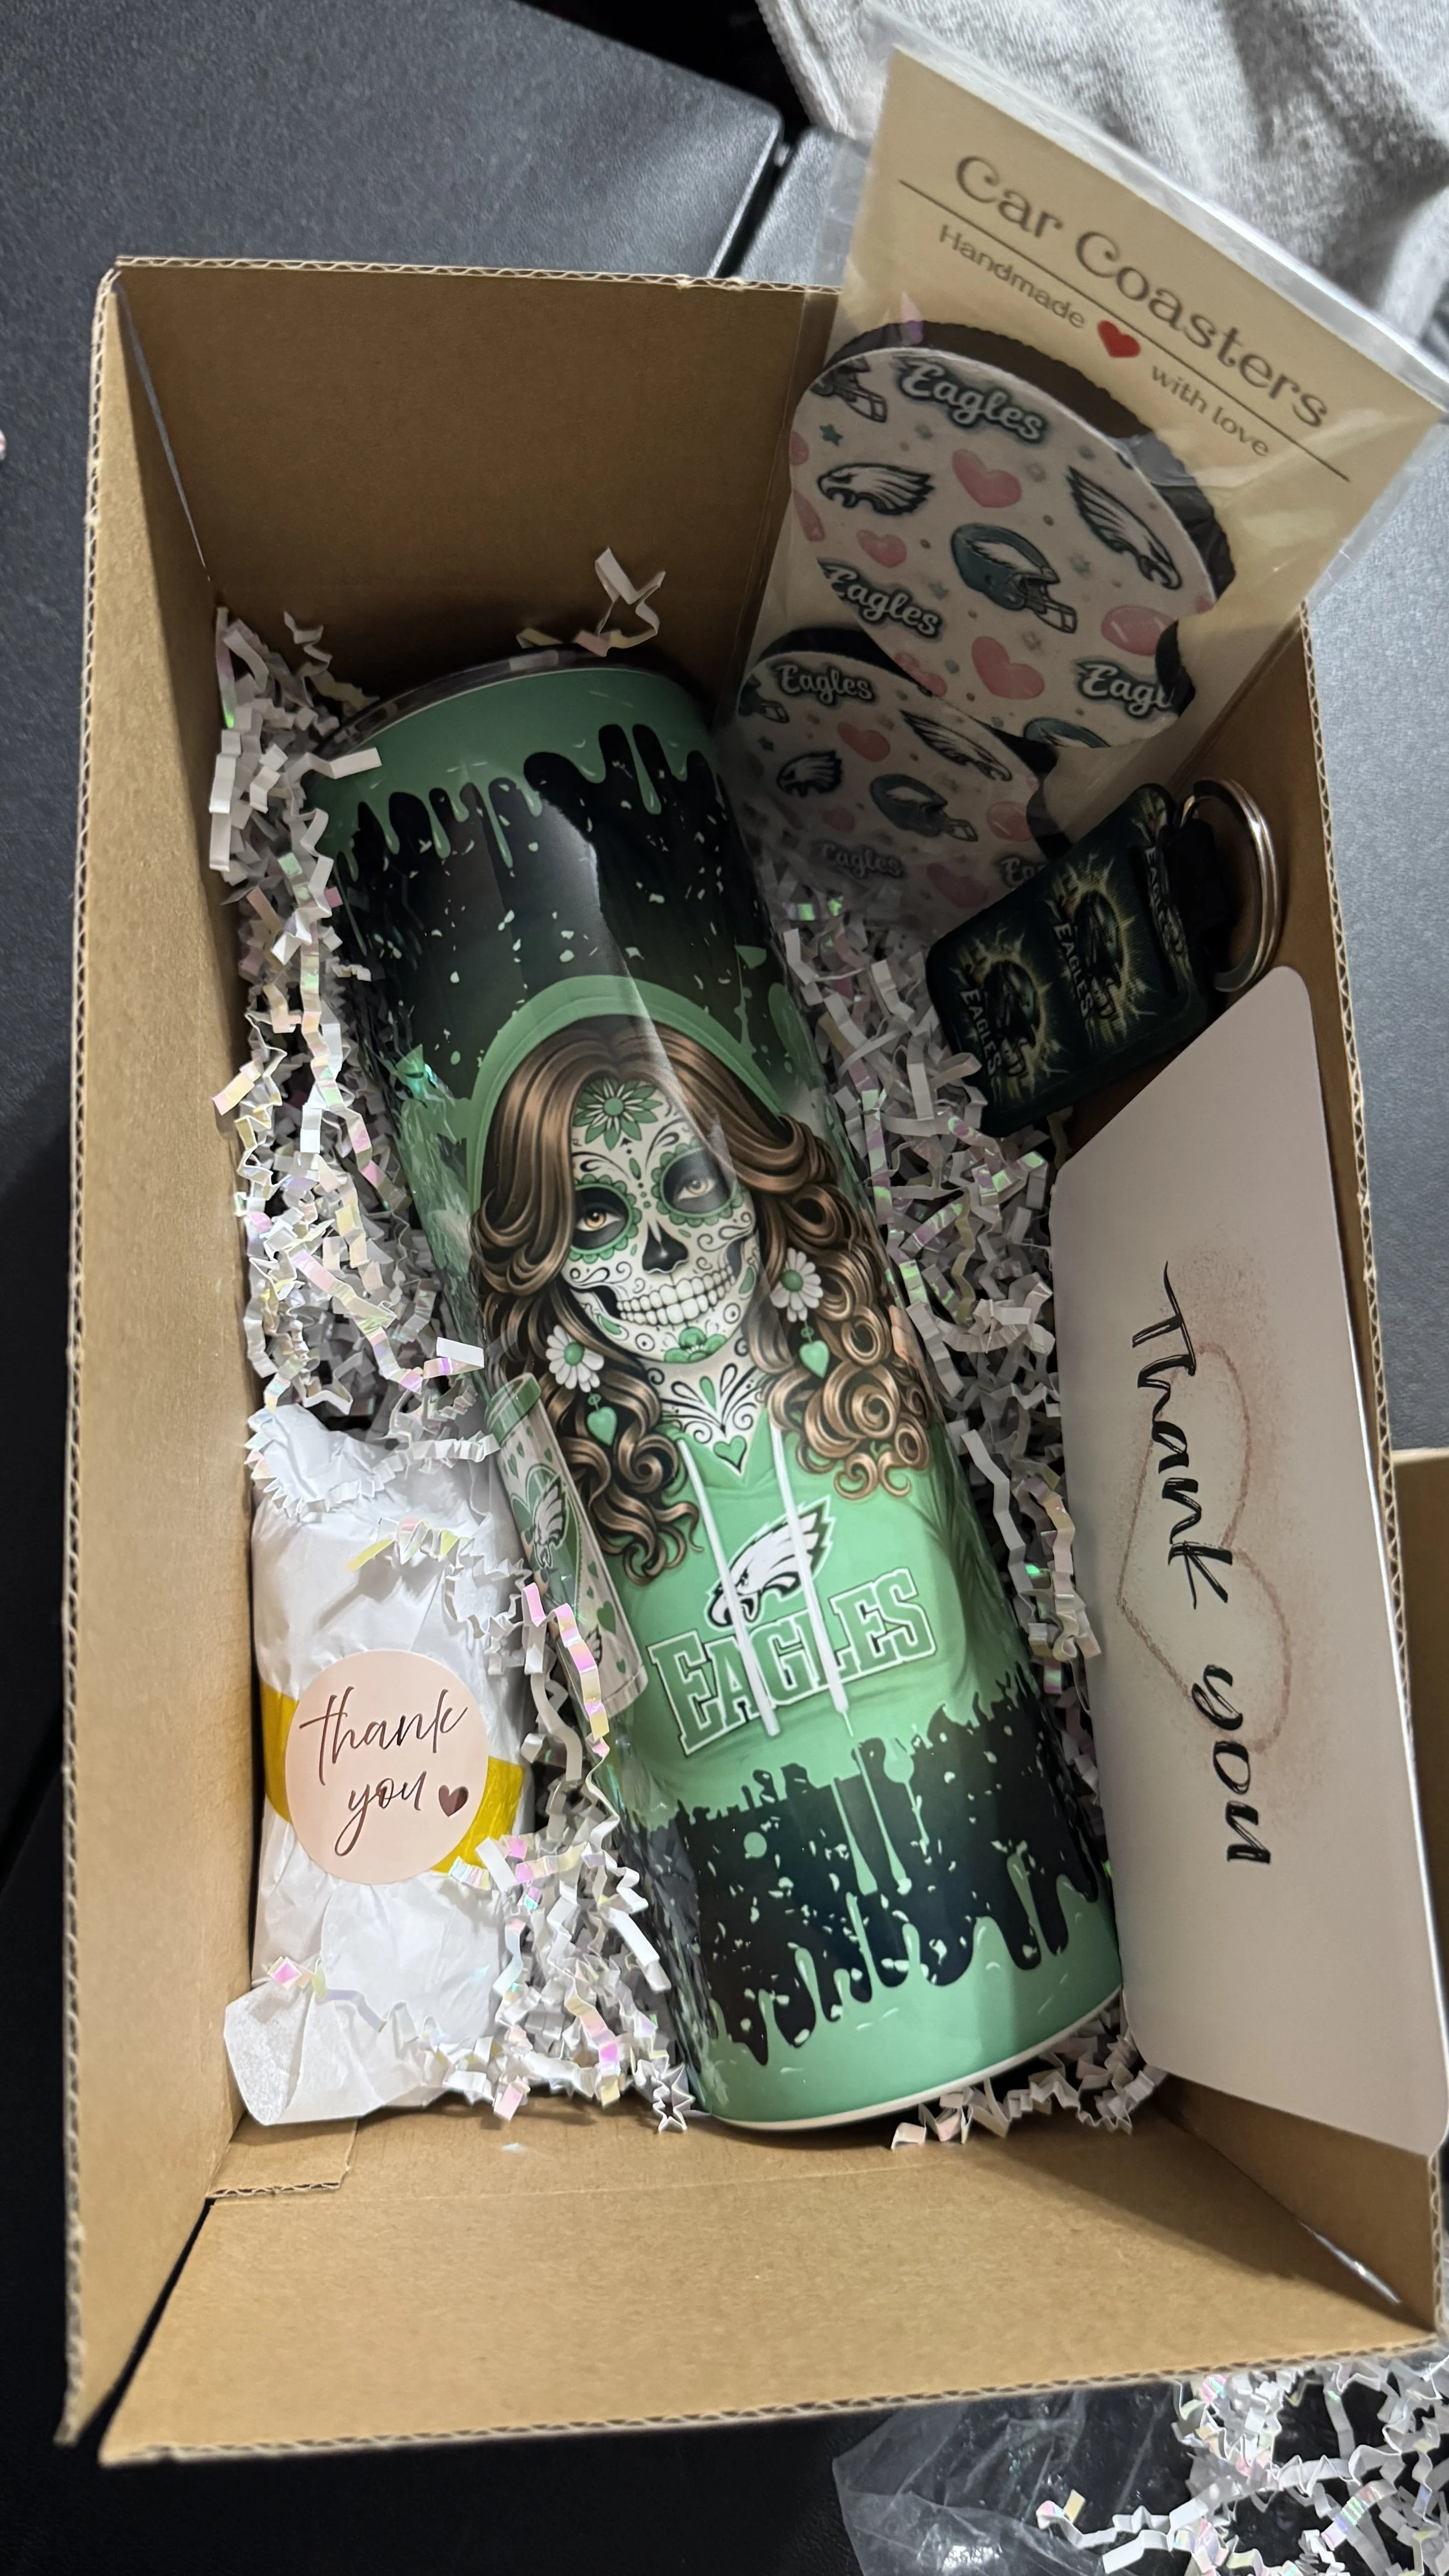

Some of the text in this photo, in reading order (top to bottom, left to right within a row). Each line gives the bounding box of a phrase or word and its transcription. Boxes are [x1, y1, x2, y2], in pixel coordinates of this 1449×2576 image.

[938, 224, 1269, 457] Handmade with love
[956, 155, 1328, 428] Car Coasters
[901, 360, 1043, 440] Eagles
[775, 664, 873, 705] Eagles
[1053, 922, 1094, 1018] EAGLES
[959, 987, 1003, 1076] EAGLES
[1132, 1260, 1271, 1865] Thank you
[647, 1567, 937, 1758] EAGLES
[298, 1686, 468, 1786] thank
[334, 1770, 427, 1856] you
